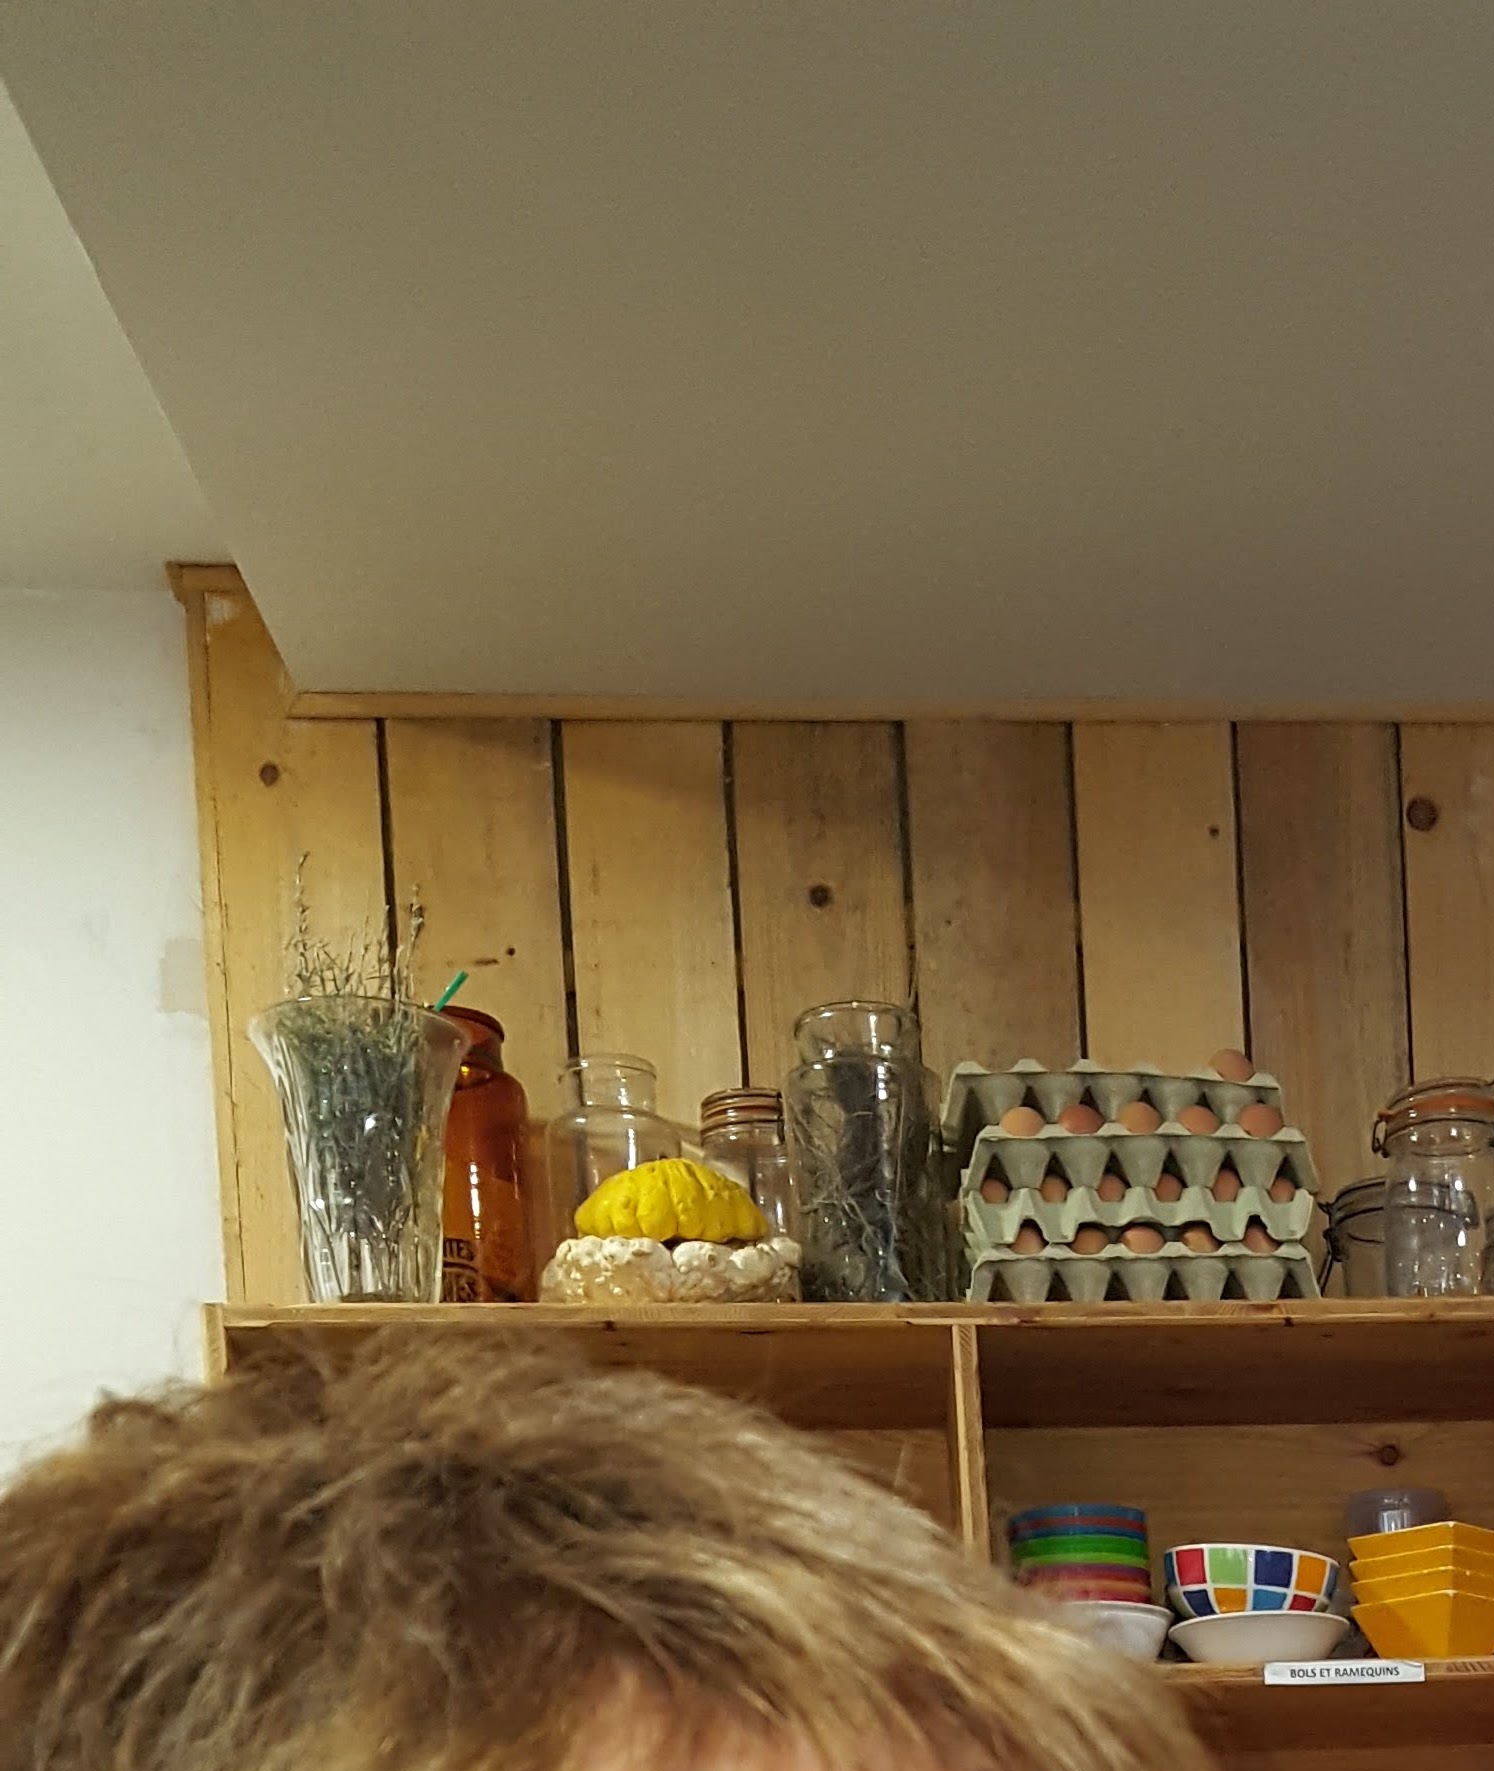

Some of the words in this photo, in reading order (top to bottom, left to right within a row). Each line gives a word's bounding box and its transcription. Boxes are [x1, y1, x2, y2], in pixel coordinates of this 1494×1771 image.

[1290, 1668, 1316, 1678] BOLS
[1320, 1668, 1331, 1678] ET
[1335, 1666, 1400, 1677] RAMEQUINS
